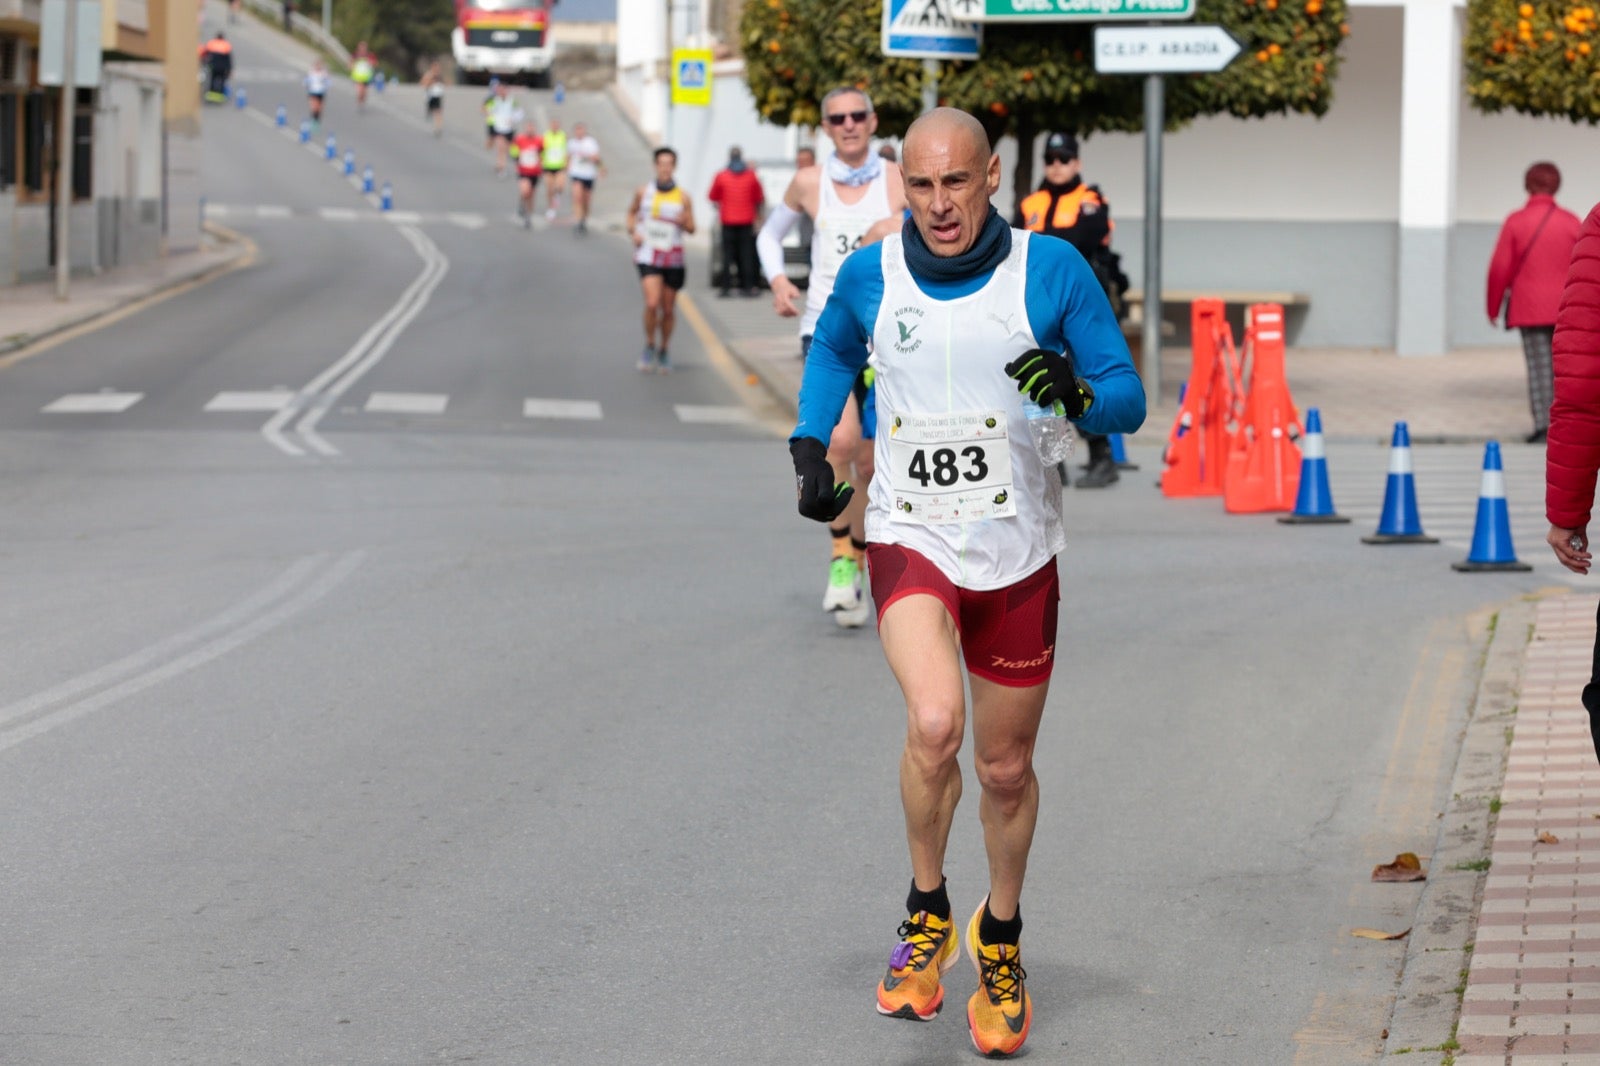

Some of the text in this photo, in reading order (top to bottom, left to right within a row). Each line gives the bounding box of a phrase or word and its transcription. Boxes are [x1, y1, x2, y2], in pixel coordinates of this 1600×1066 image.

[894, 306, 925, 318] RUNNING
[893, 339, 922, 355] VAMPIROS
[908, 445, 989, 487] 483
